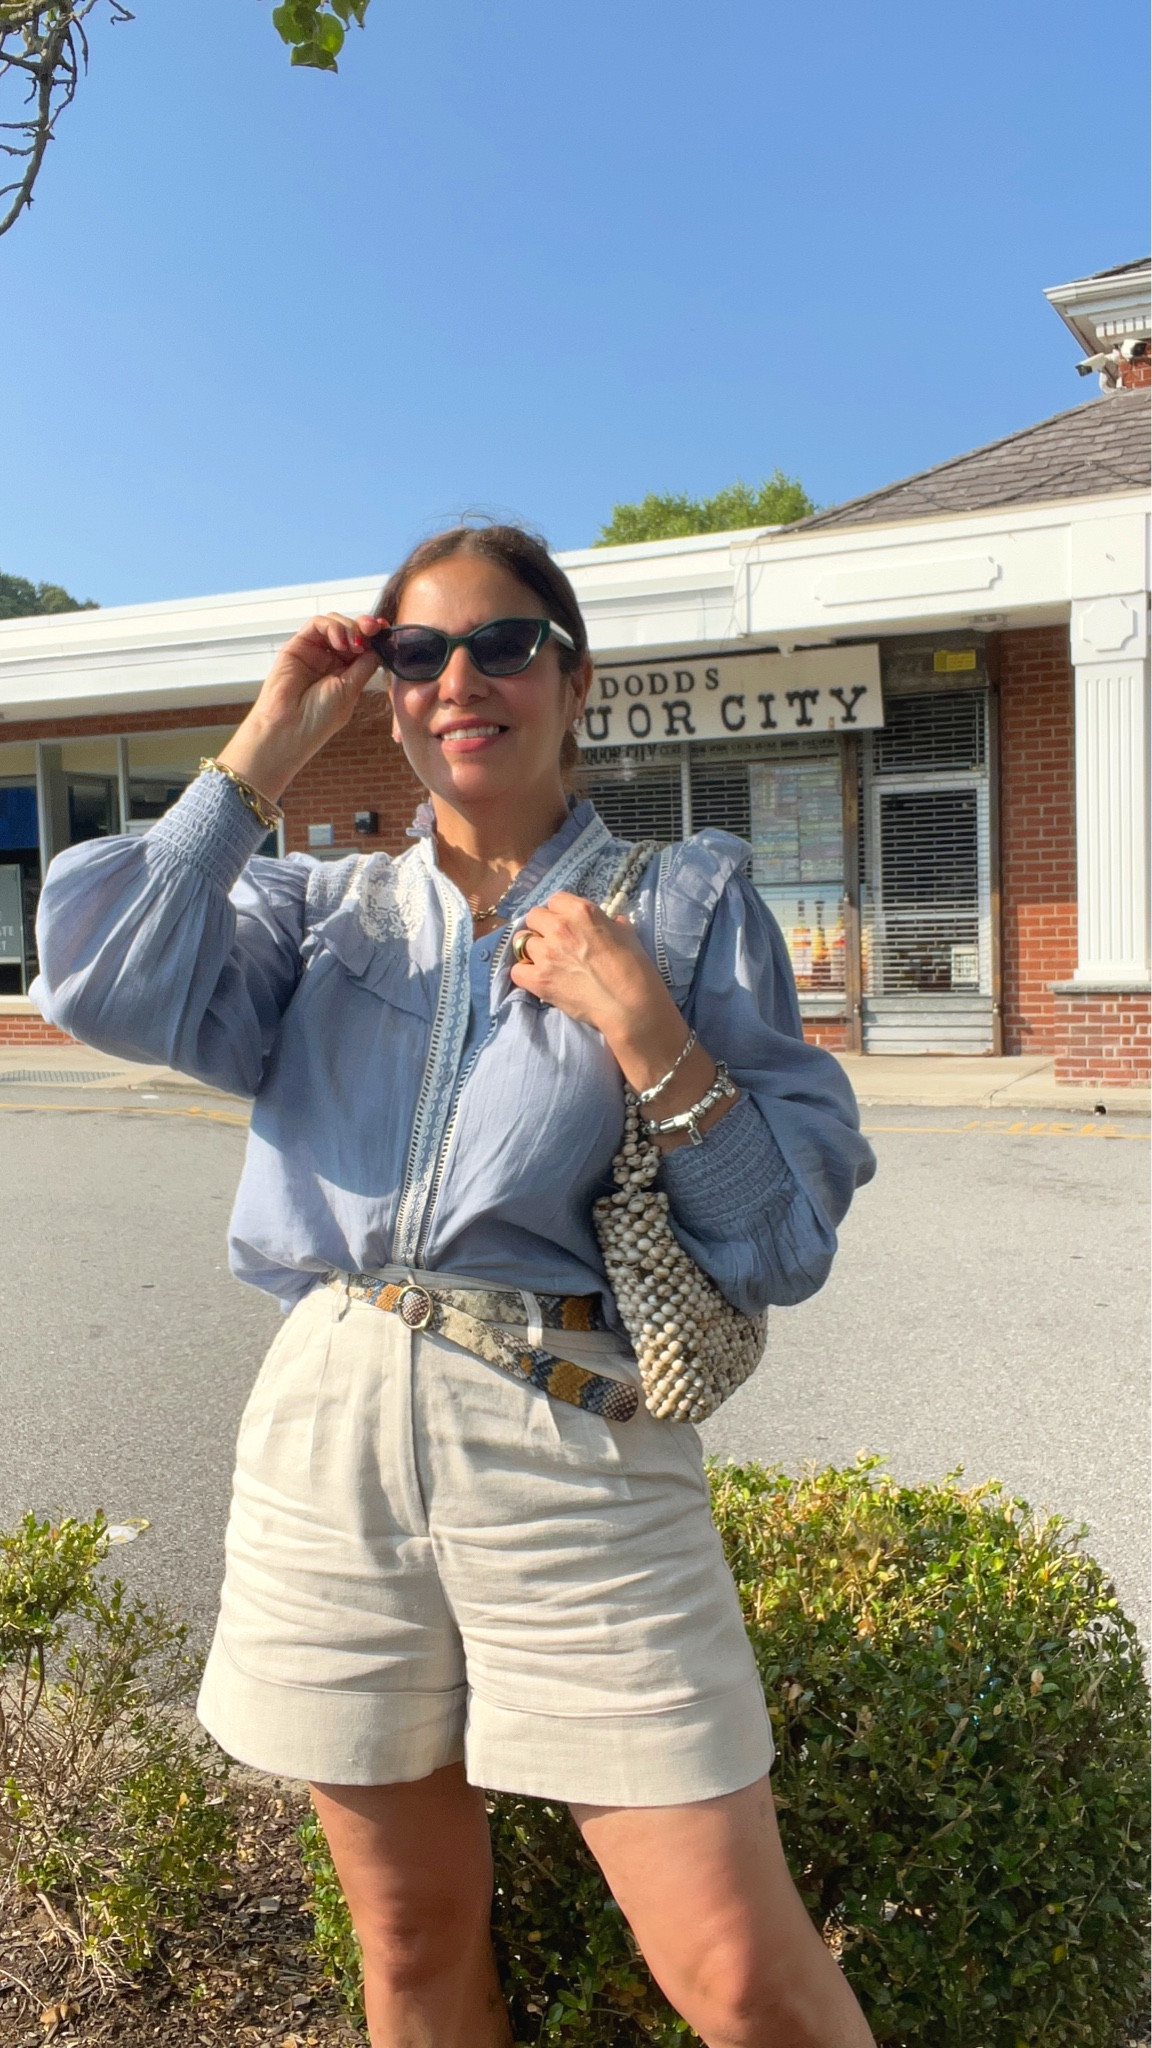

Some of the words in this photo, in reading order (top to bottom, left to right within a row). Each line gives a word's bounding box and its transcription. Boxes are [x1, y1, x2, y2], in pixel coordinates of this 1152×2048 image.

[598, 667, 719, 699] DODDS
[584, 700, 696, 741] UOR
[720, 685, 868, 731] CITY
